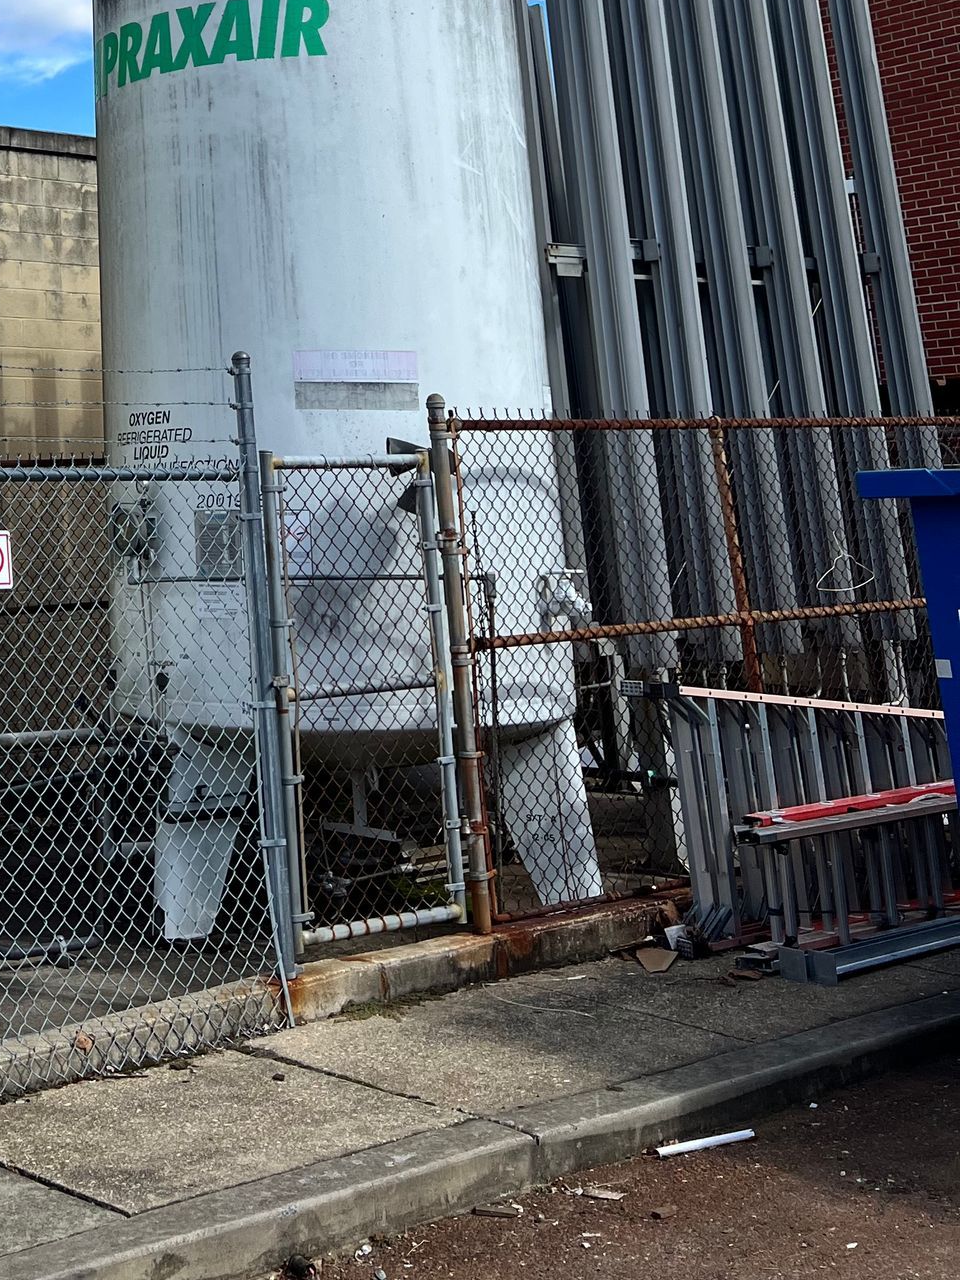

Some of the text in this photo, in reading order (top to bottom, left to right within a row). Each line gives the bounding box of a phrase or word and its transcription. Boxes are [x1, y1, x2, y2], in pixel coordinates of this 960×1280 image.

[129, 410, 171, 427] OXYGEN
[117, 427, 193, 446] REFRIGERATED
[134, 444, 169, 461] LIQUID
